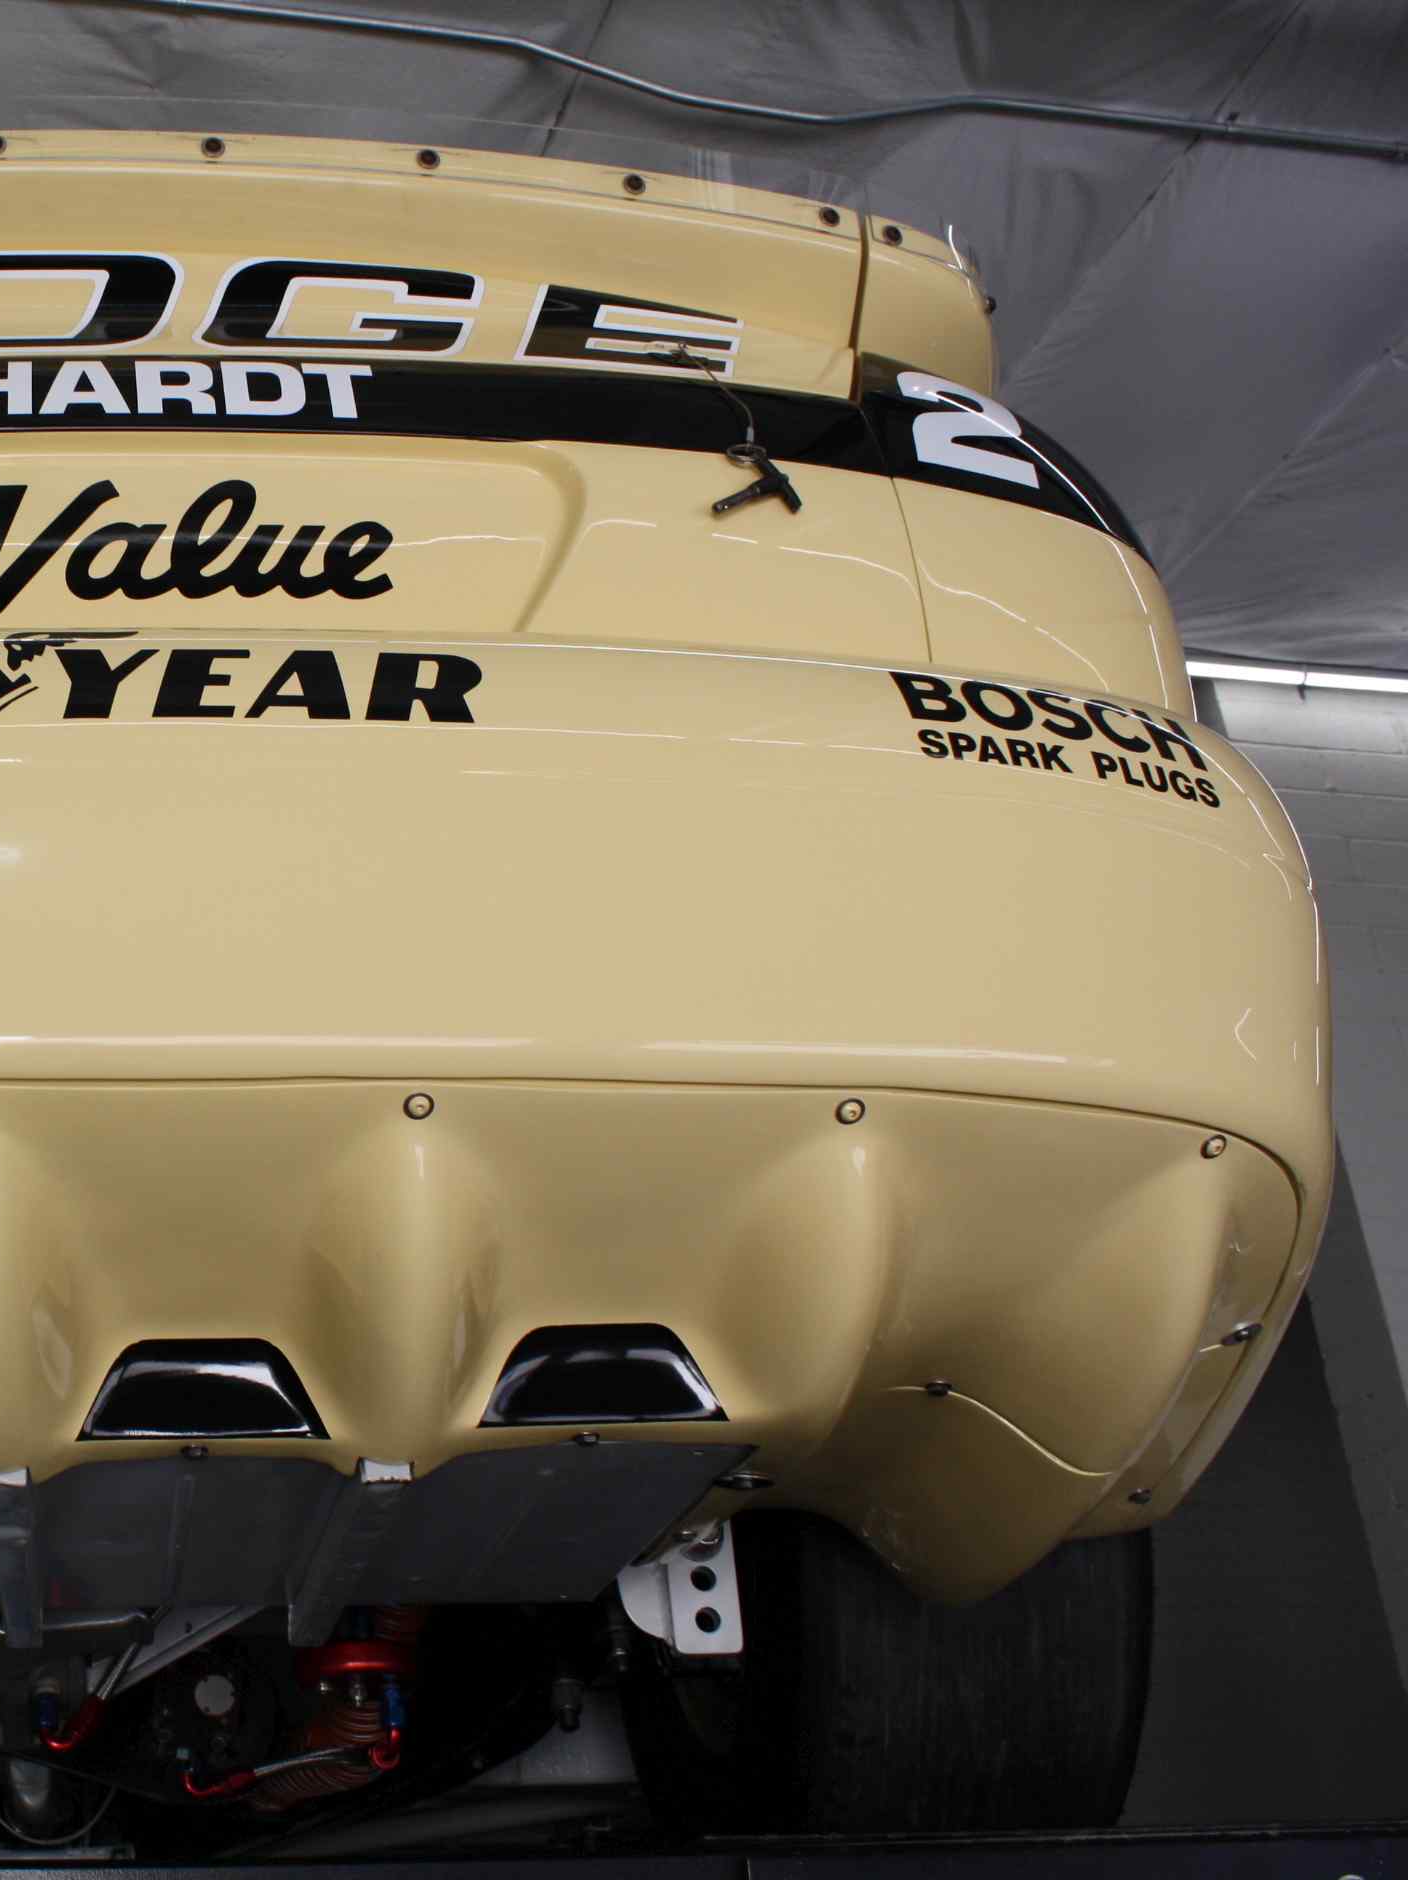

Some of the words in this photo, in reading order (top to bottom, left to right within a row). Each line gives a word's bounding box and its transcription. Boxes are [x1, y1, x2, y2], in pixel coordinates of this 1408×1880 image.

[896, 371, 1040, 489] 2
[888, 671, 1209, 772] BOSCH
[919, 728, 1073, 774] SPARK
[1090, 750, 1222, 809] PLUGS
